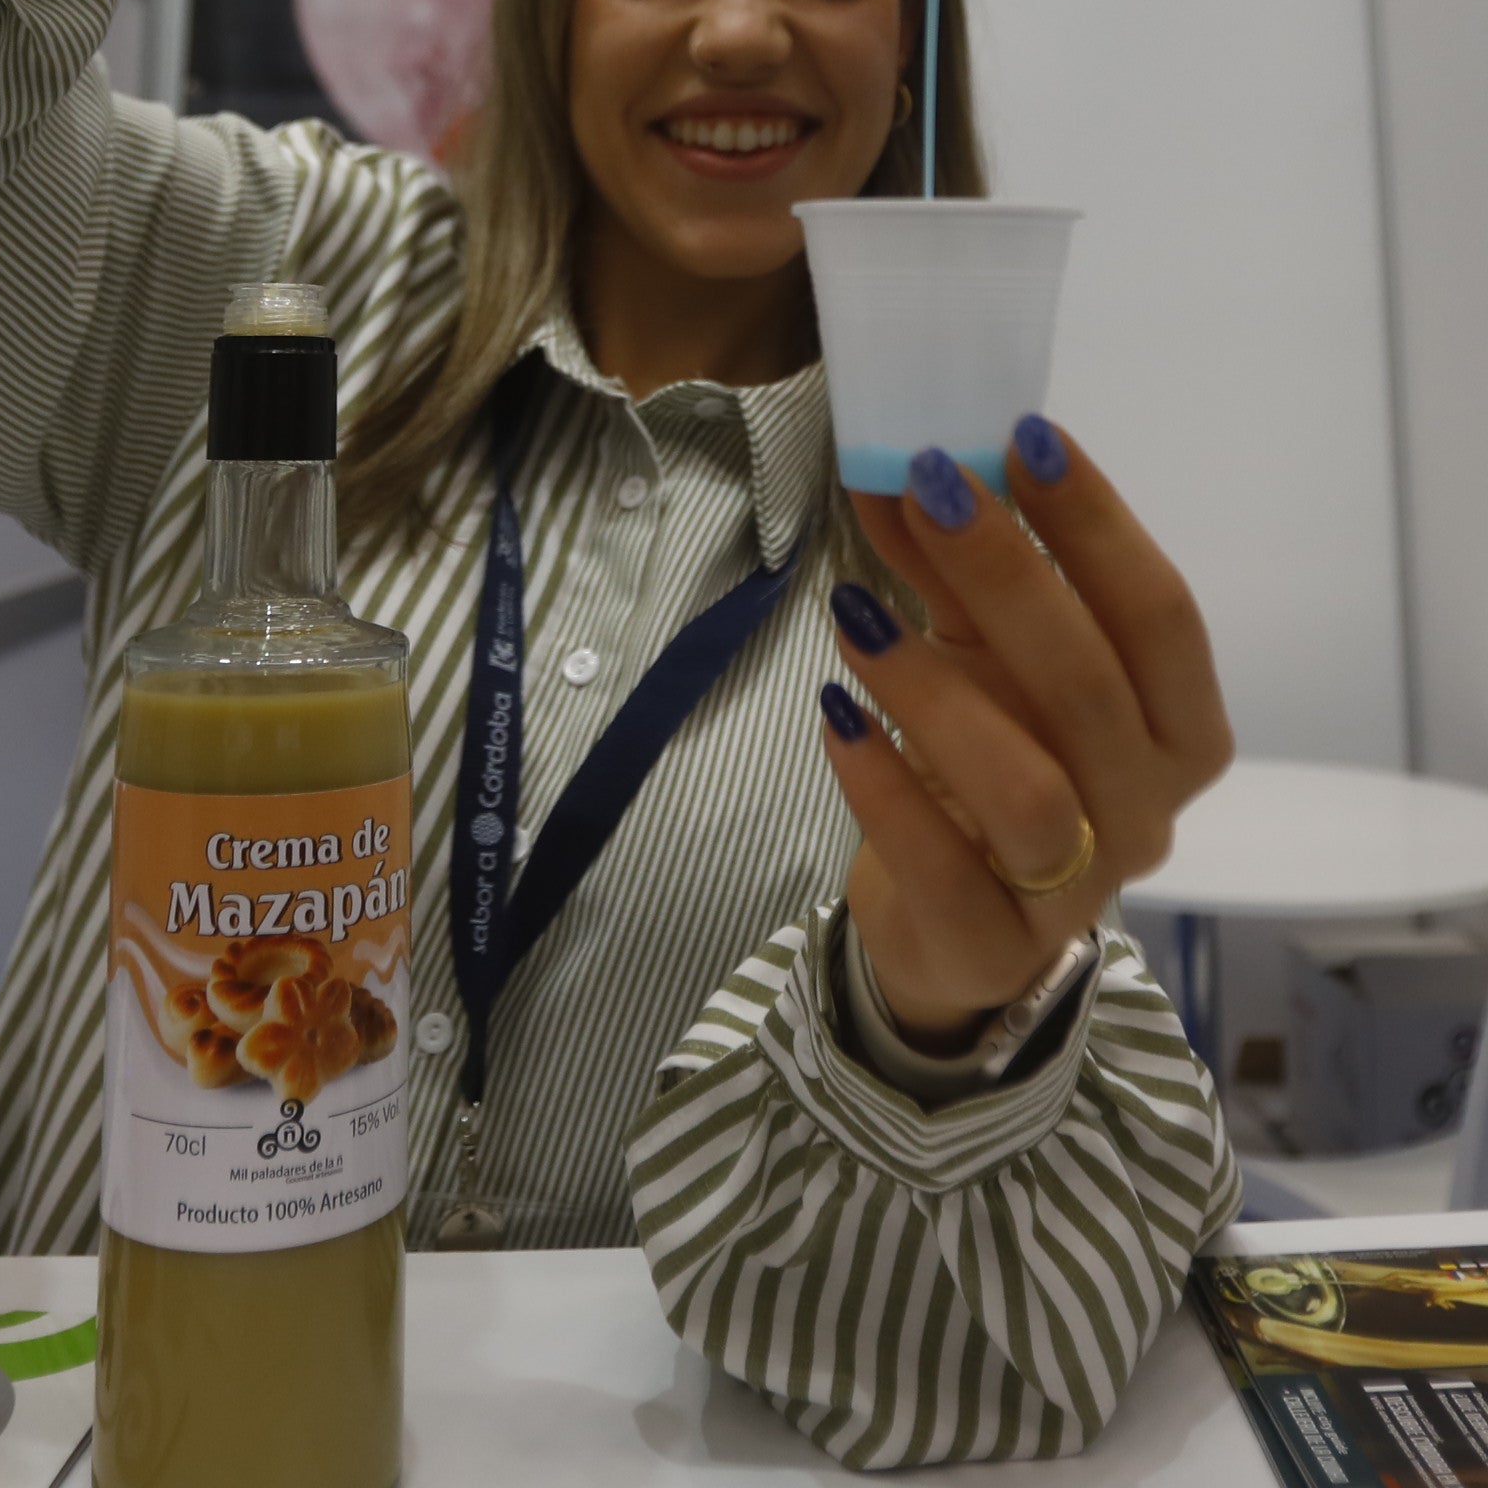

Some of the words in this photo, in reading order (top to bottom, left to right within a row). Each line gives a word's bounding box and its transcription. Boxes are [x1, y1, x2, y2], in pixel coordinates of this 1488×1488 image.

[206, 832, 342, 871] Crema
[352, 817, 390, 860] de
[165, 860, 408, 944] Mazapán
[349, 1111, 380, 1138] 15%
[164, 1133, 206, 1157] 70cl
[229, 1168, 248, 1182] Mil
[251, 1162, 307, 1183] paladares
[309, 1158, 324, 1173] de
[325, 1155, 334, 1169] la
[177, 1200, 259, 1224] Producto
[265, 1196, 316, 1222] 100%
[319, 1176, 384, 1212] Artesano
